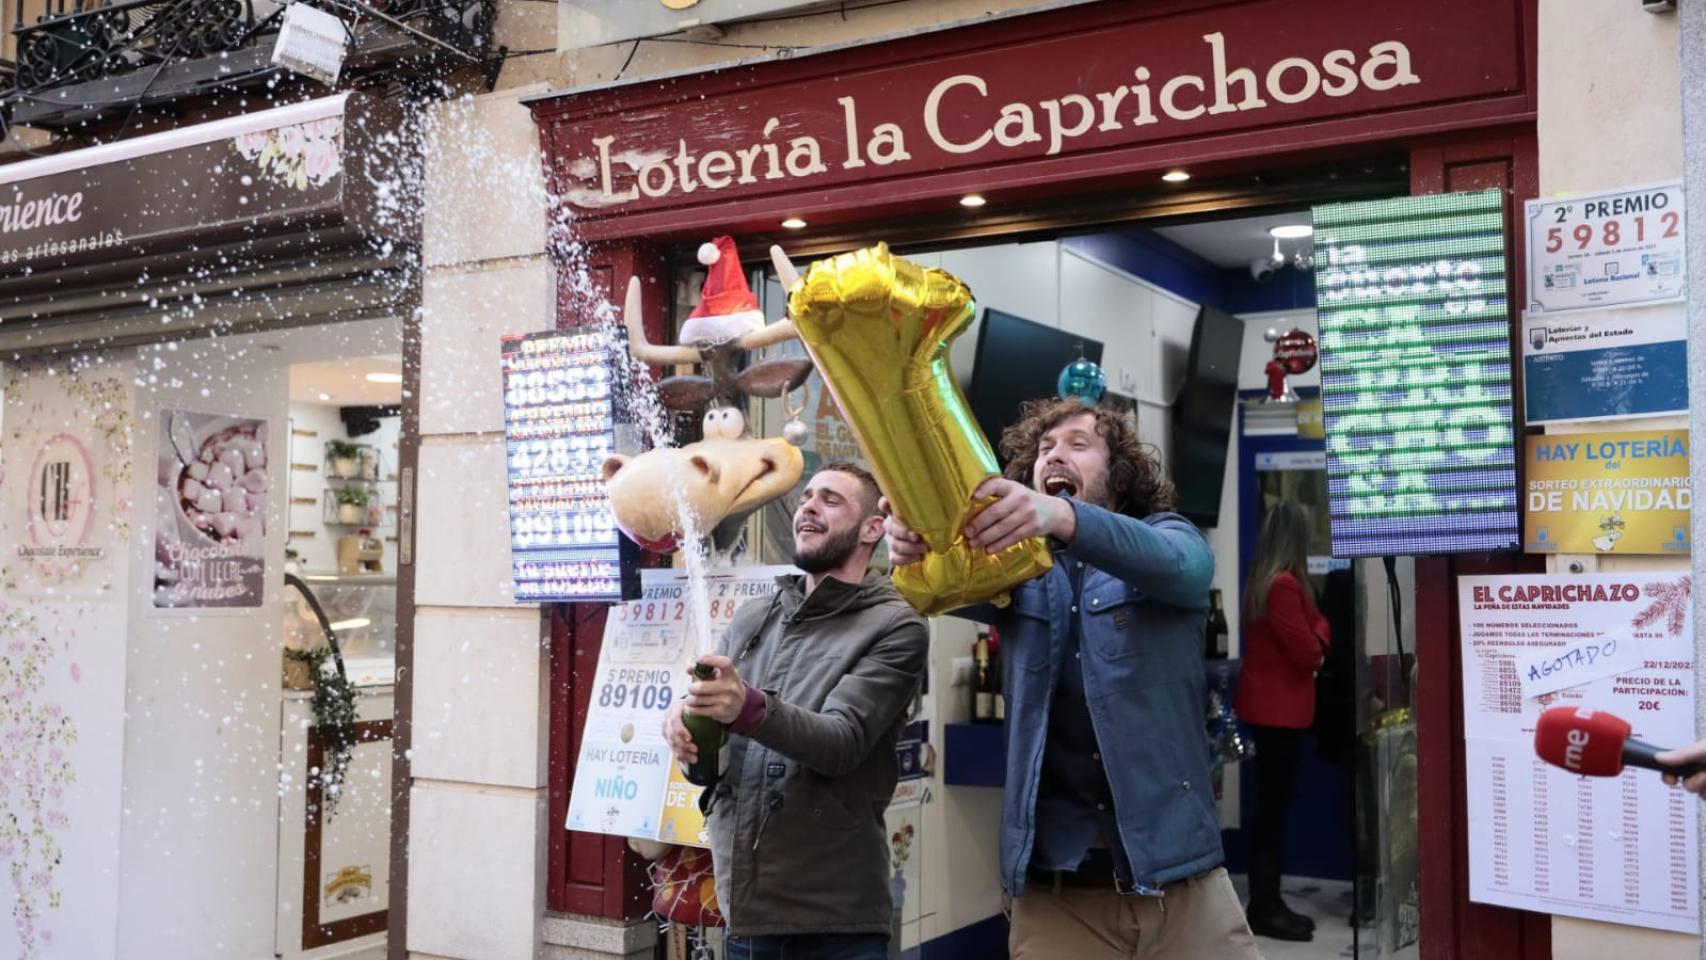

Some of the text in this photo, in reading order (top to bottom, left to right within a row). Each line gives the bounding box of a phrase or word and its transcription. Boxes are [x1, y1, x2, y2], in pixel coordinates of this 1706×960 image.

[592, 31, 1421, 201] Lotería la Caprichosa
[1584, 192, 1669, 219] PREMIO
[1546, 211, 1680, 254] 59812
[26, 230, 123, 260] artesanales
[1604, 329, 1634, 337] Estado
[1536, 435, 1687, 462] HAY LOTERÍA
[1605, 460, 1621, 469] del
[1529, 478, 1578, 491] SORTEO
[1529, 489, 1692, 512] DE NAVIDAD
[734, 582, 778, 597] PREMIO
[1473, 584, 1640, 602] EL CAPRICHAZO
[619, 602, 685, 622] 59812
[1527, 640, 1617, 681] AGOTADO
[619, 669, 671, 685] PREMIO
[1616, 677, 1681, 686] PRECIO DE LA
[598, 684, 673, 711] 89109
[1638, 700, 1661, 711] 20€
[586, 748, 661, 766] HAY LOTERÍA
[1565, 729, 1589, 770] rne
[595, 775, 638, 801] NIÑO
[667, 790, 688, 807] DE
